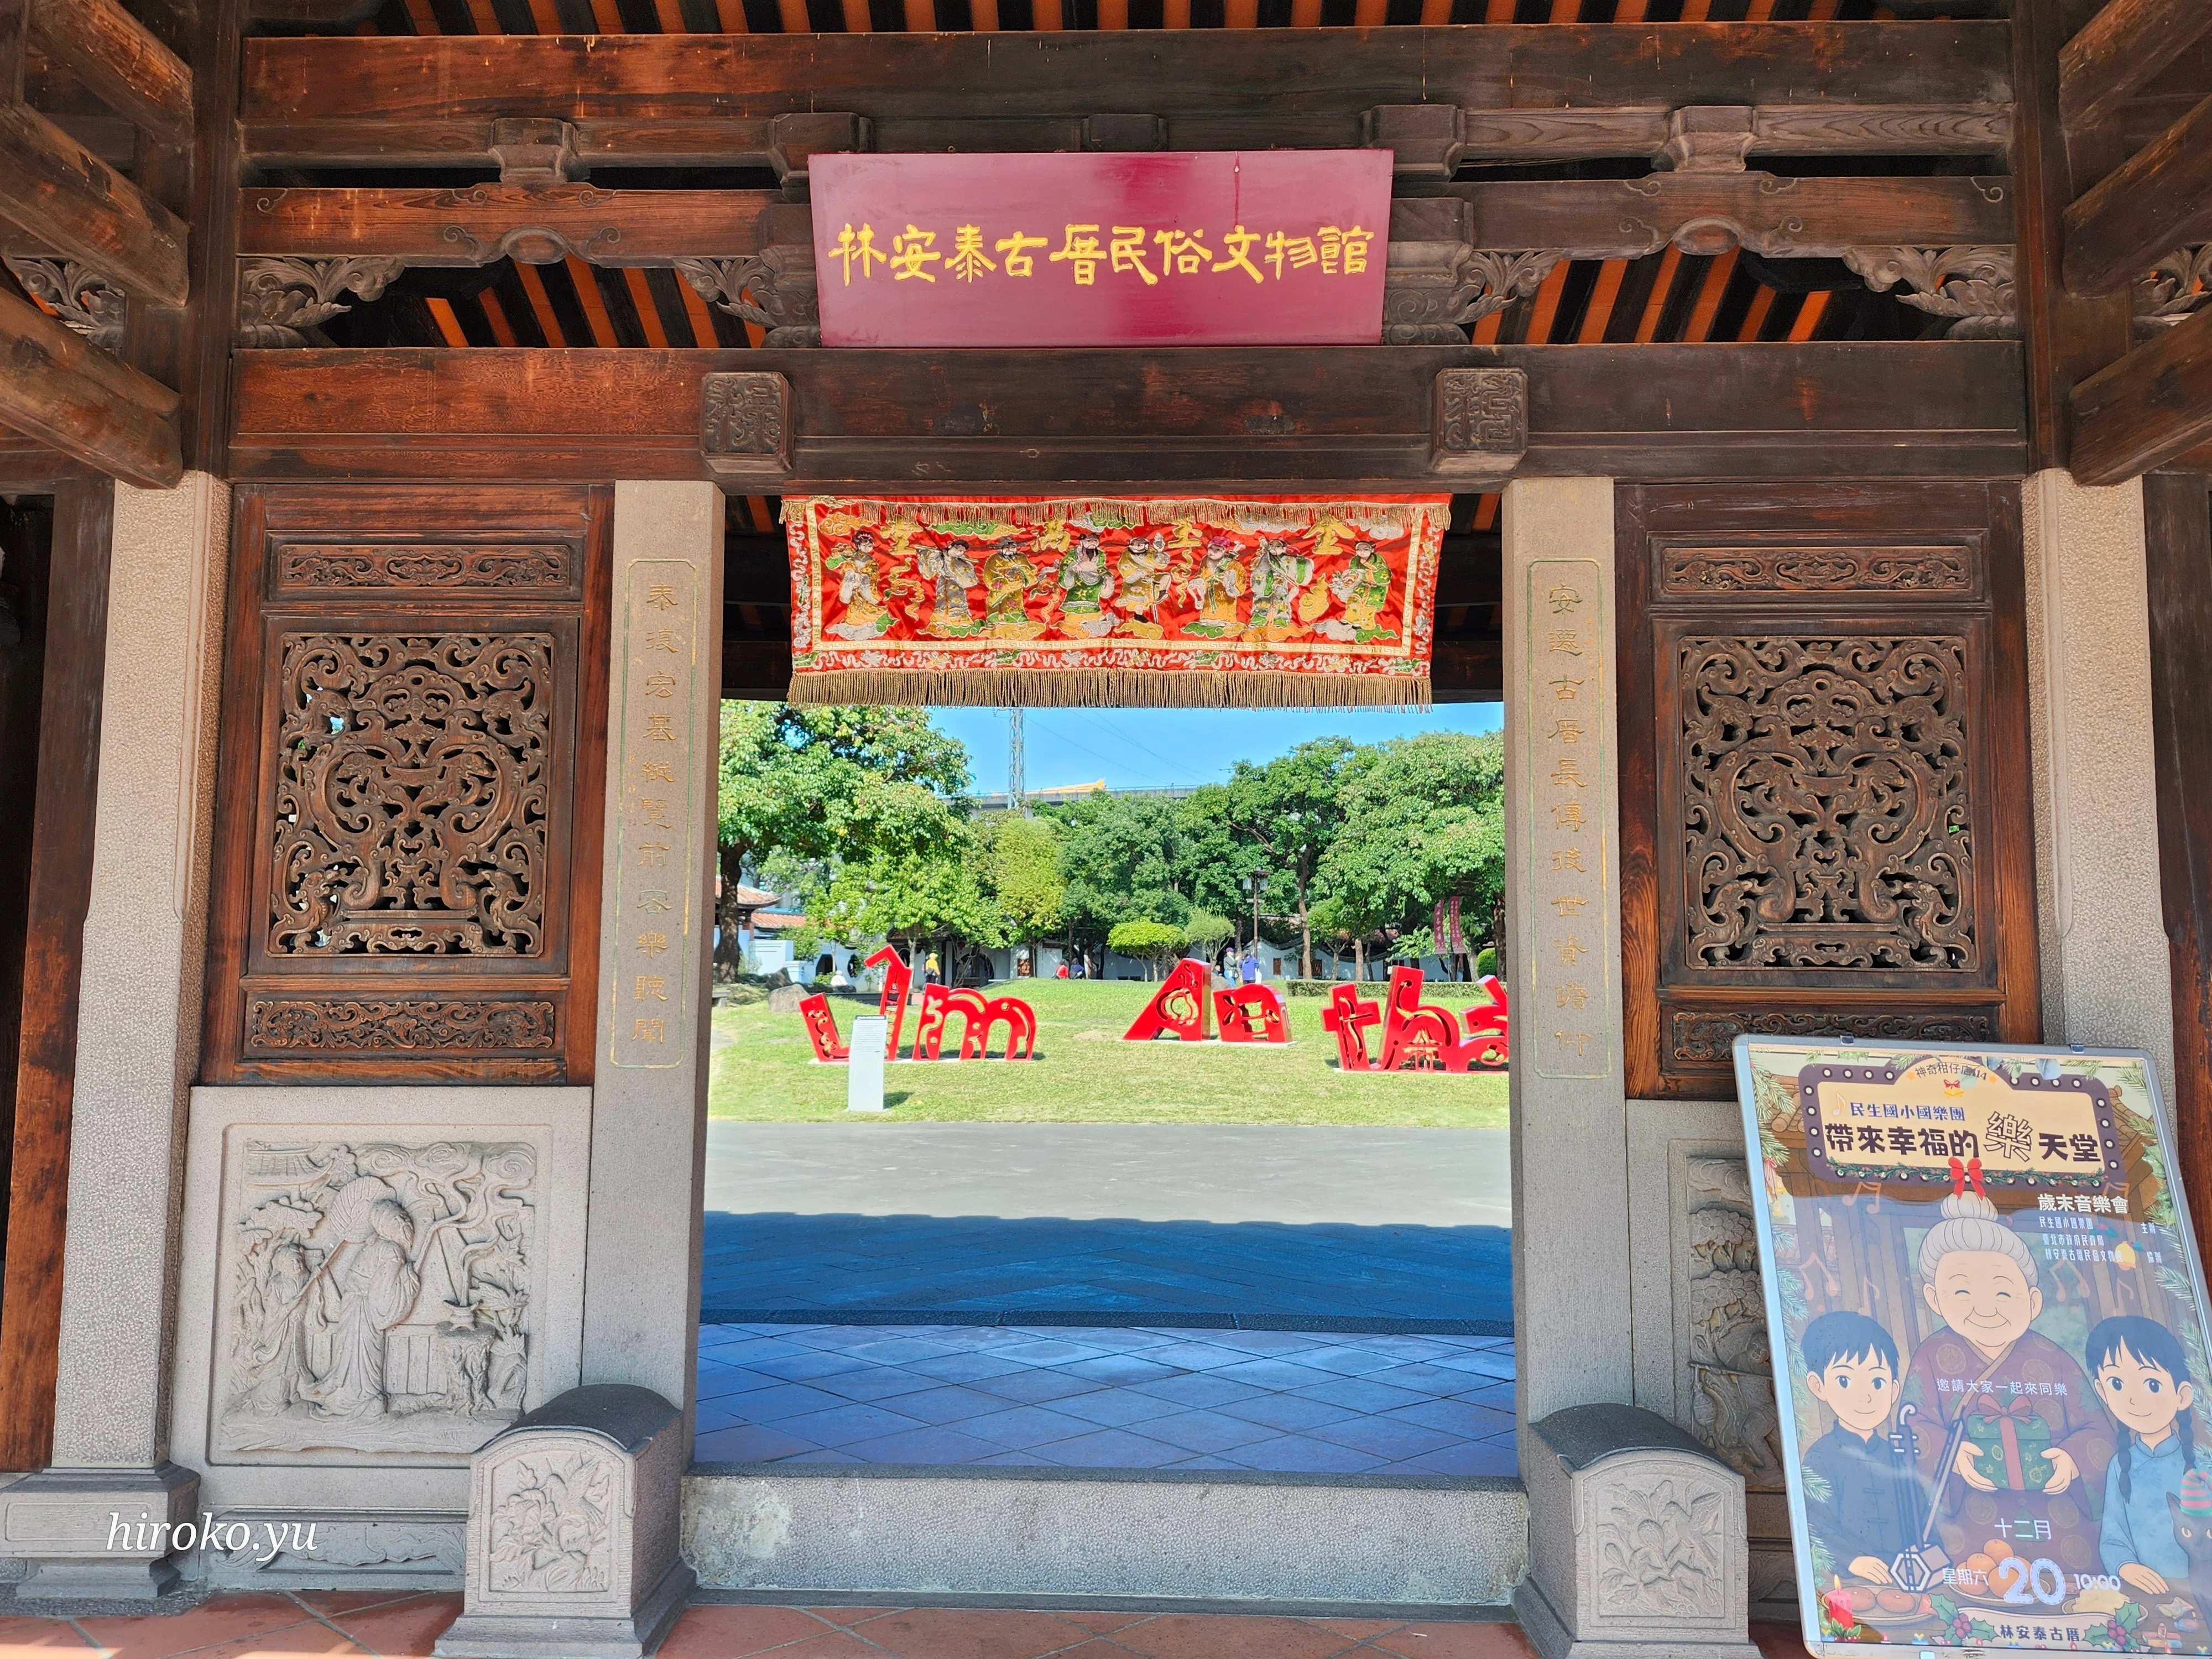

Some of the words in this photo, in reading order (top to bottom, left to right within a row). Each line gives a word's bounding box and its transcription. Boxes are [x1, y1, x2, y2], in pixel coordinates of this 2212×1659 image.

[828, 223, 1375, 286] 林安泰古厝民俗文物館
[1849, 1102, 1966, 1121] 民生國小國樂團
[2037, 1193, 2128, 1214] 歲末音樂會
[1937, 1378, 2068, 1396] 邀請大家一起來同樂
[1994, 1517, 2052, 1540] 十二月
[1942, 1566, 1989, 1587] 星期六
[1999, 1557, 2067, 1605] 20
[2073, 1573, 2121, 1592] 10:00
[1999, 1624, 2080, 1642] 林安泰古厝
